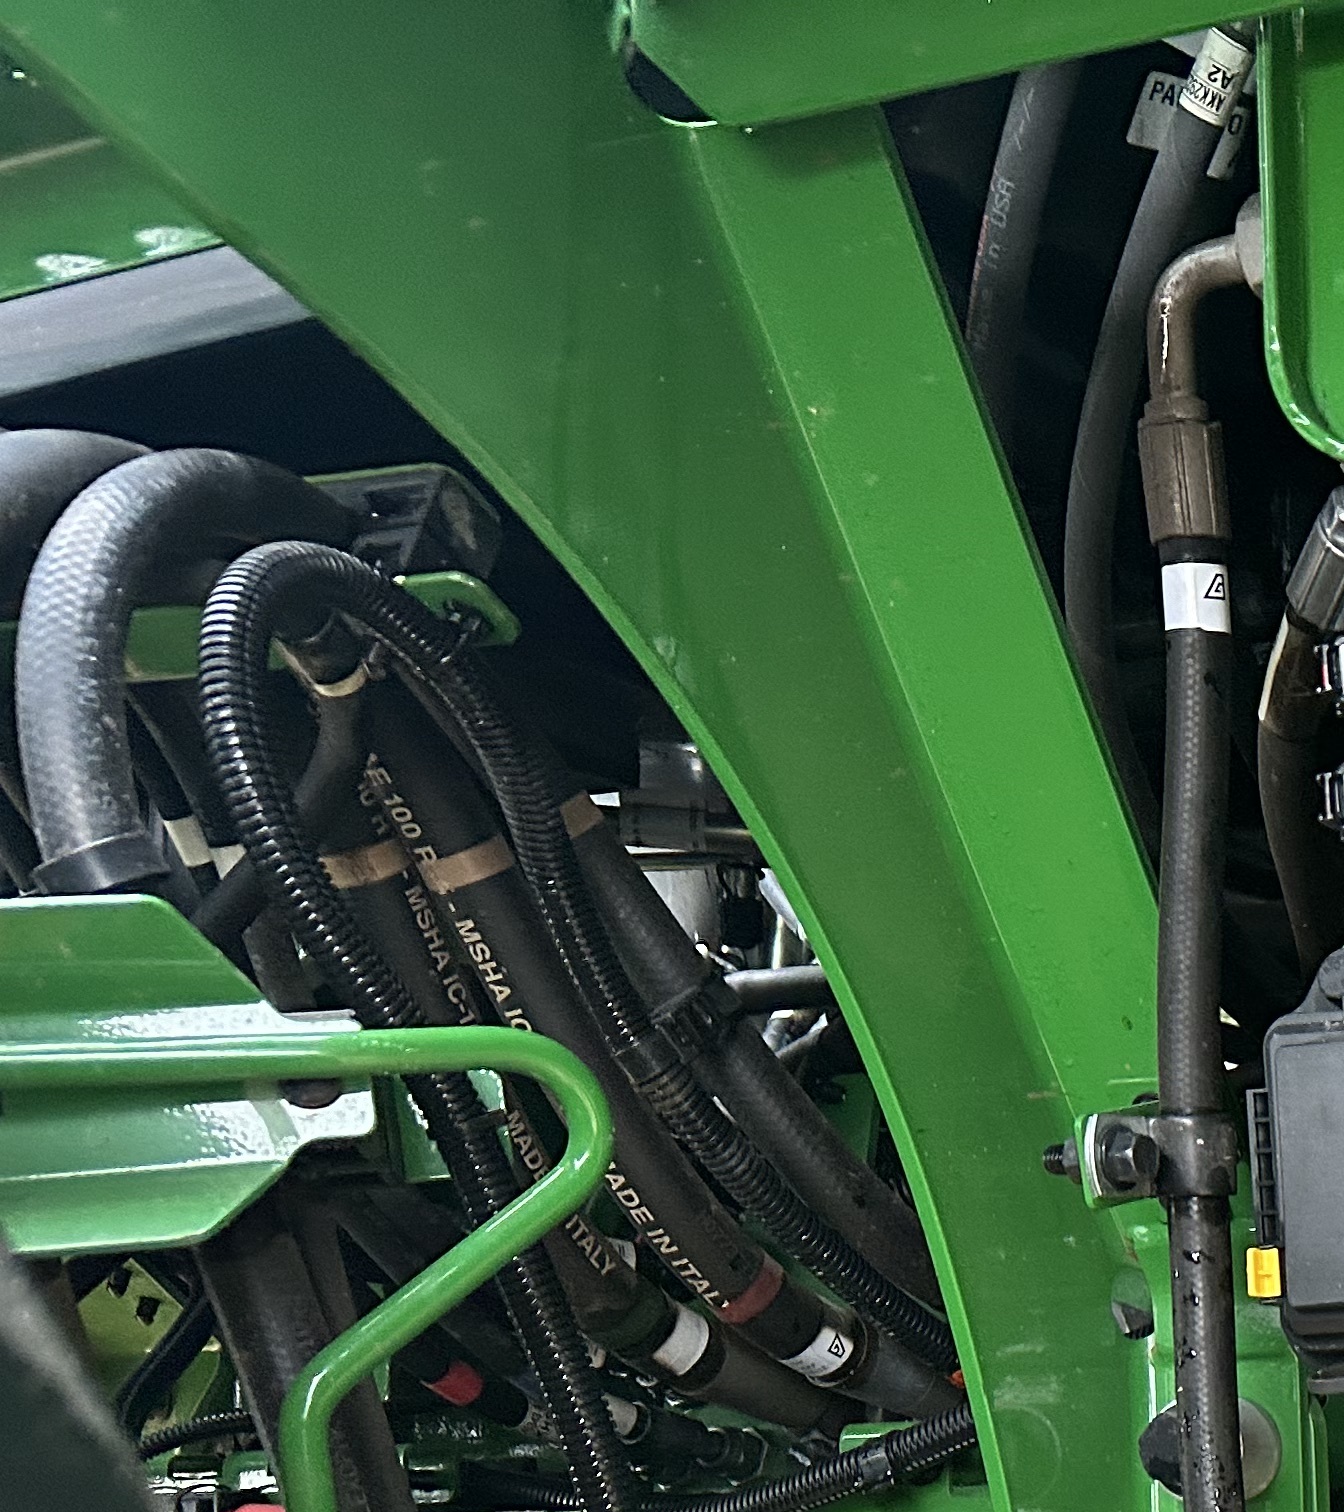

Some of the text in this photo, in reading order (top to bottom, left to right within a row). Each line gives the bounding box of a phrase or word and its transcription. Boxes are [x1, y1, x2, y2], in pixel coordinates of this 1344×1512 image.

[1207, 64, 1234, 89] A2
[384, 793, 422, 839] 100
[454, 918, 512, 1004] MSHA
[404, 886, 451, 974] MSHA
[565, 1214, 616, 1276] ITALY
[605, 1161, 654, 1226] ADE
[647, 1228, 681, 1258] IN
